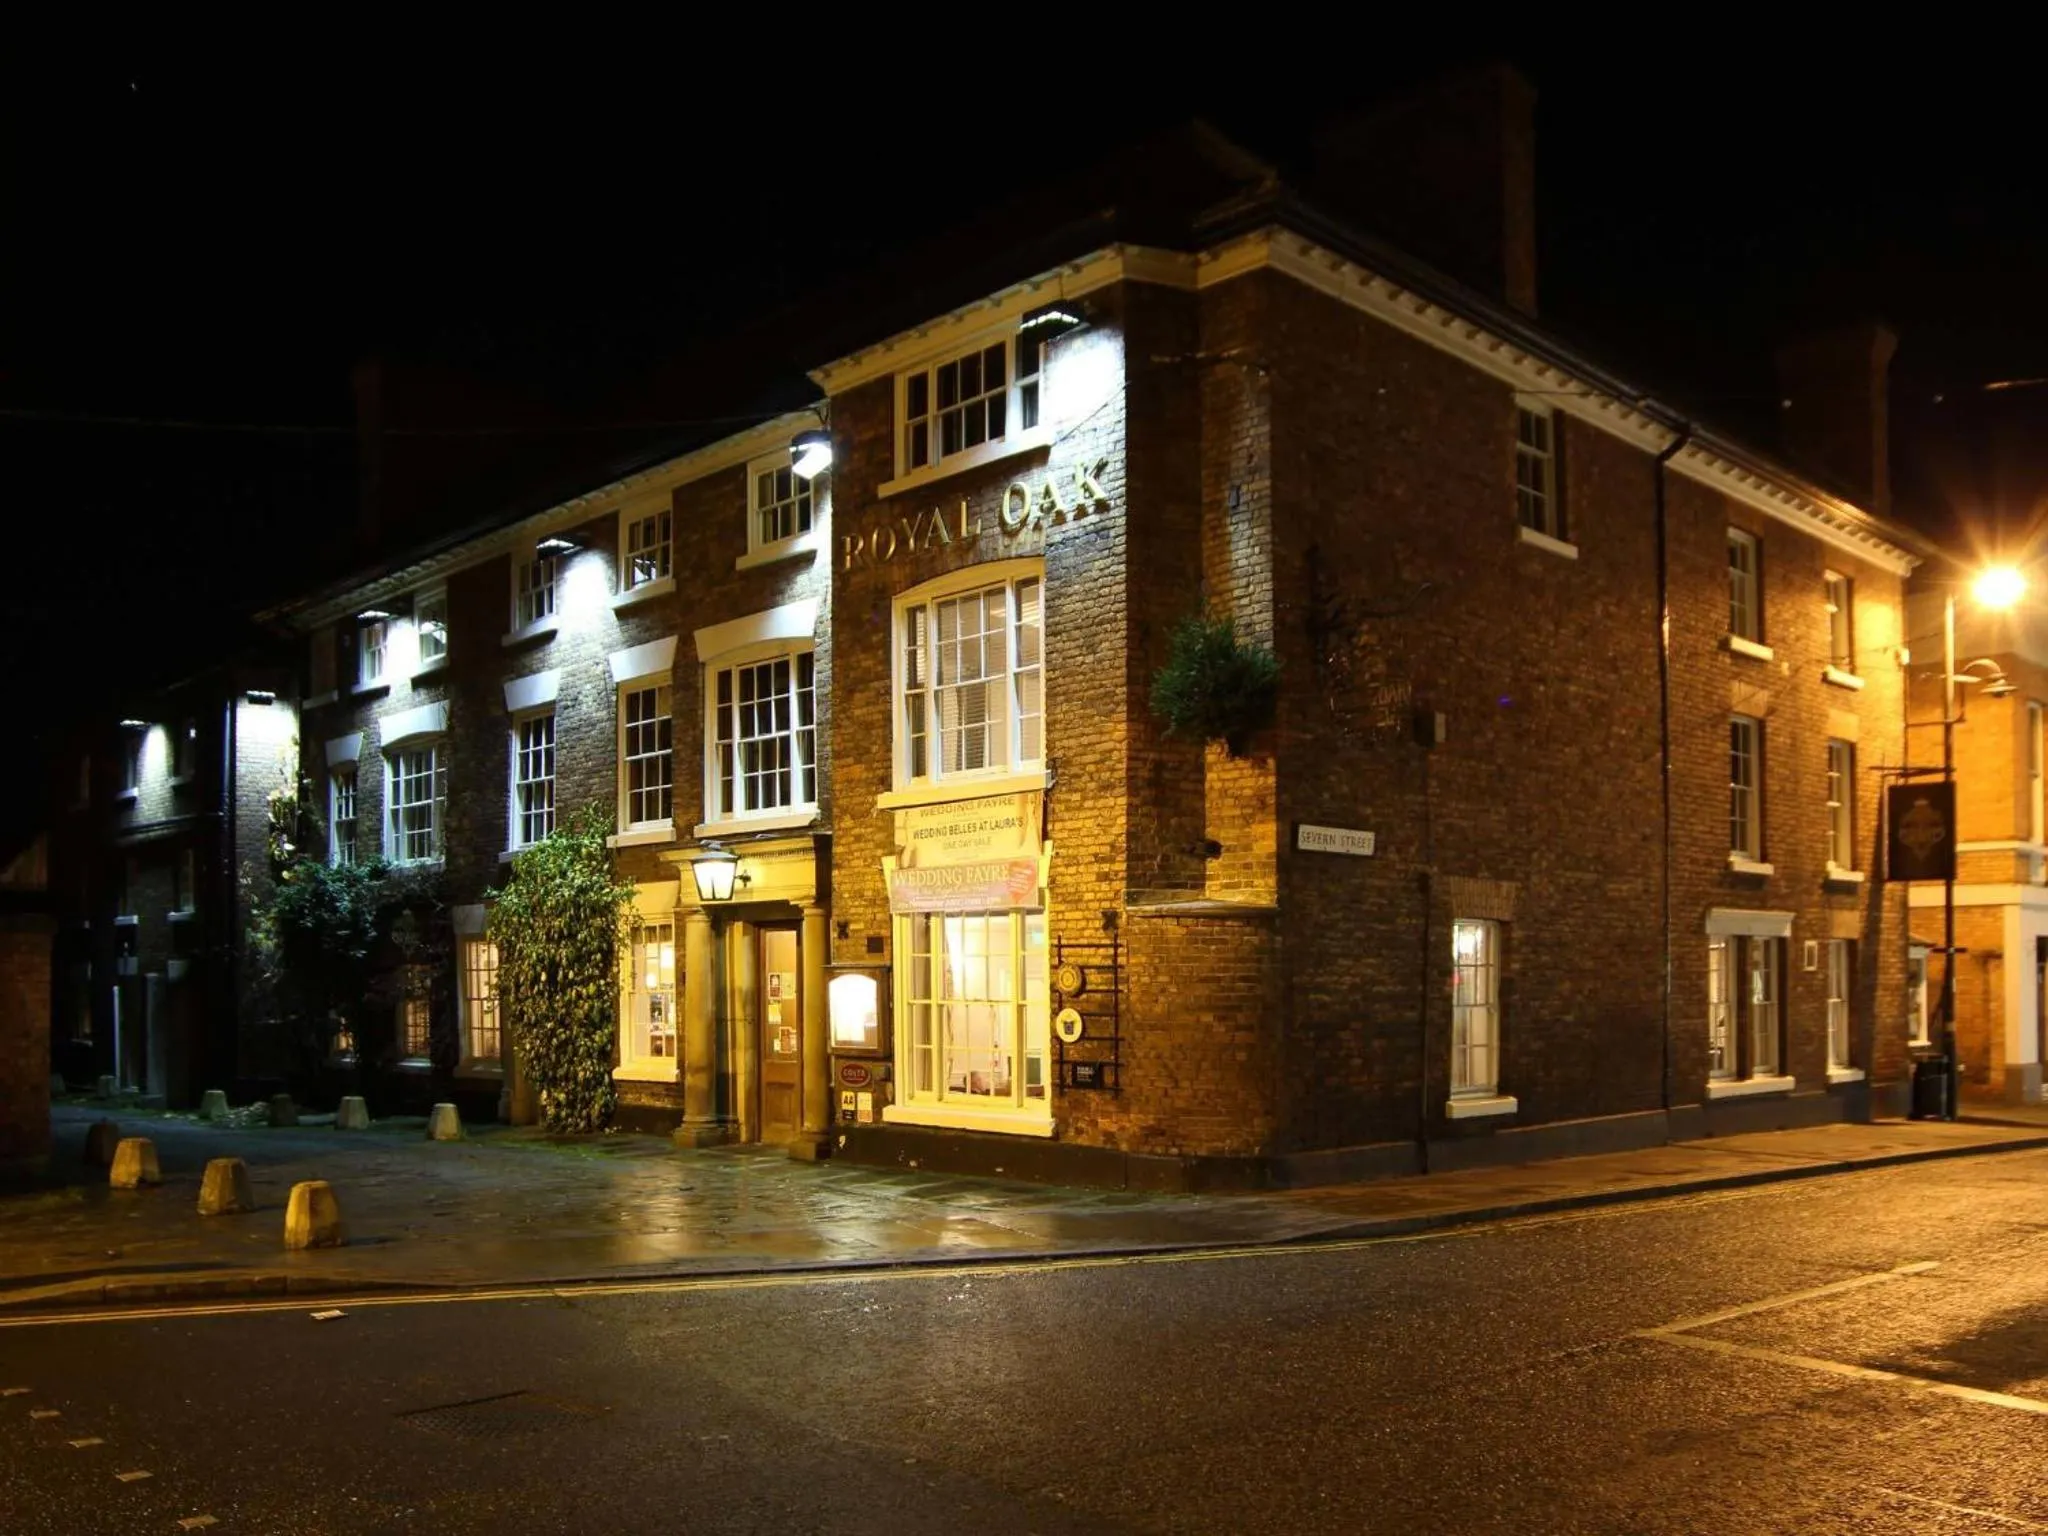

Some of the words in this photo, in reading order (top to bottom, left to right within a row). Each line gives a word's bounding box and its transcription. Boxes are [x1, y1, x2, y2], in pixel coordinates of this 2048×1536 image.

[842, 497, 982, 570] ROYAL
[1001, 456, 1110, 526] OAK
[913, 826, 948, 839] WEDDING
[949, 822, 977, 836] BELLES
[979, 820, 990, 832] AT
[990, 817, 1024, 831] LAURA'S
[1301, 831, 1337, 846] SEVERN
[894, 866, 963, 887] WEDDING
